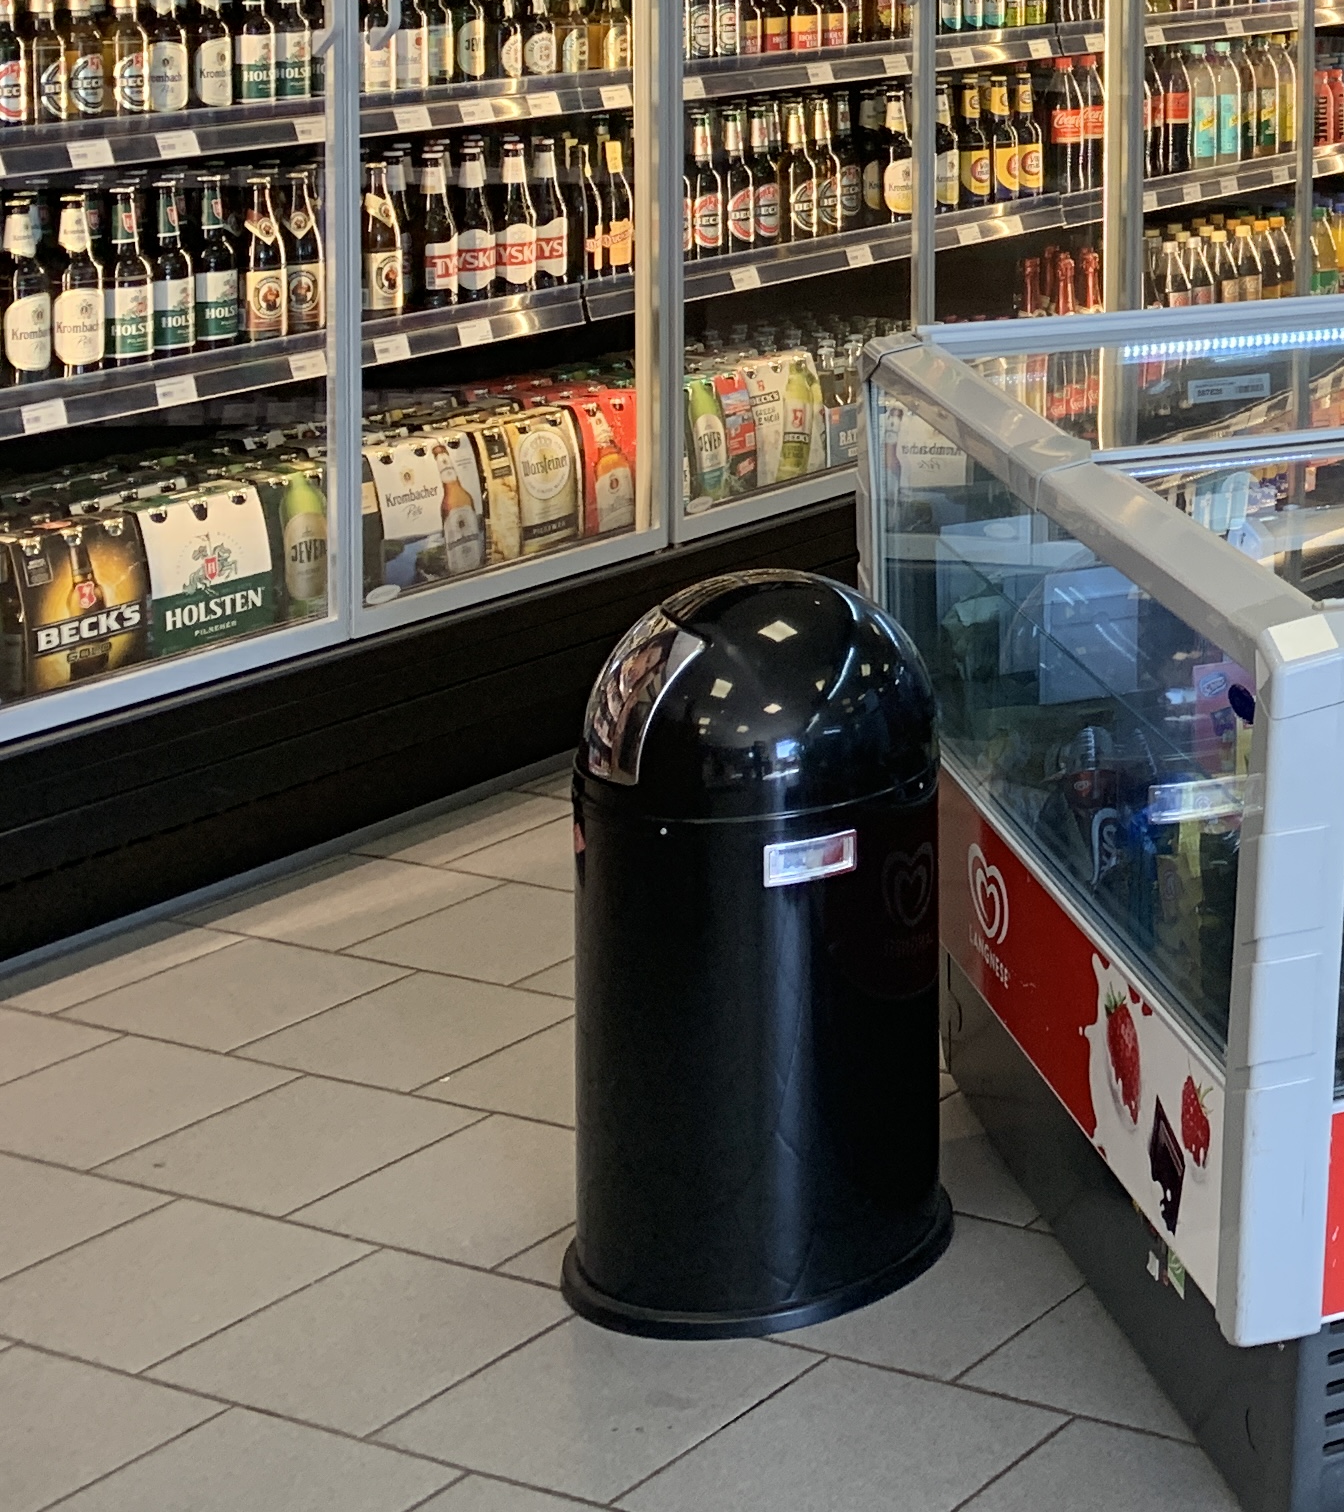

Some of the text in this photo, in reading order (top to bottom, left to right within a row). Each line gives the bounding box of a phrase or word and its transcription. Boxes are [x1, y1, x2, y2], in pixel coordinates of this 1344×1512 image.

[465, 38, 483, 51] JEV
[244, 70, 274, 82] HOLS
[162, 314, 194, 328] HOLS
[205, 307, 237, 320] HOLS
[56, 321, 102, 335] Krombach
[699, 432, 722, 452] JEVER
[522, 454, 568, 477] Warsteiner
[385, 485, 438, 507] Krombacher
[165, 587, 263, 632] HOLSTEN
[38, 604, 141, 652] BECK'S
[67, 642, 112, 663] GOLD
[968, 927, 1010, 989] LANGNESE
